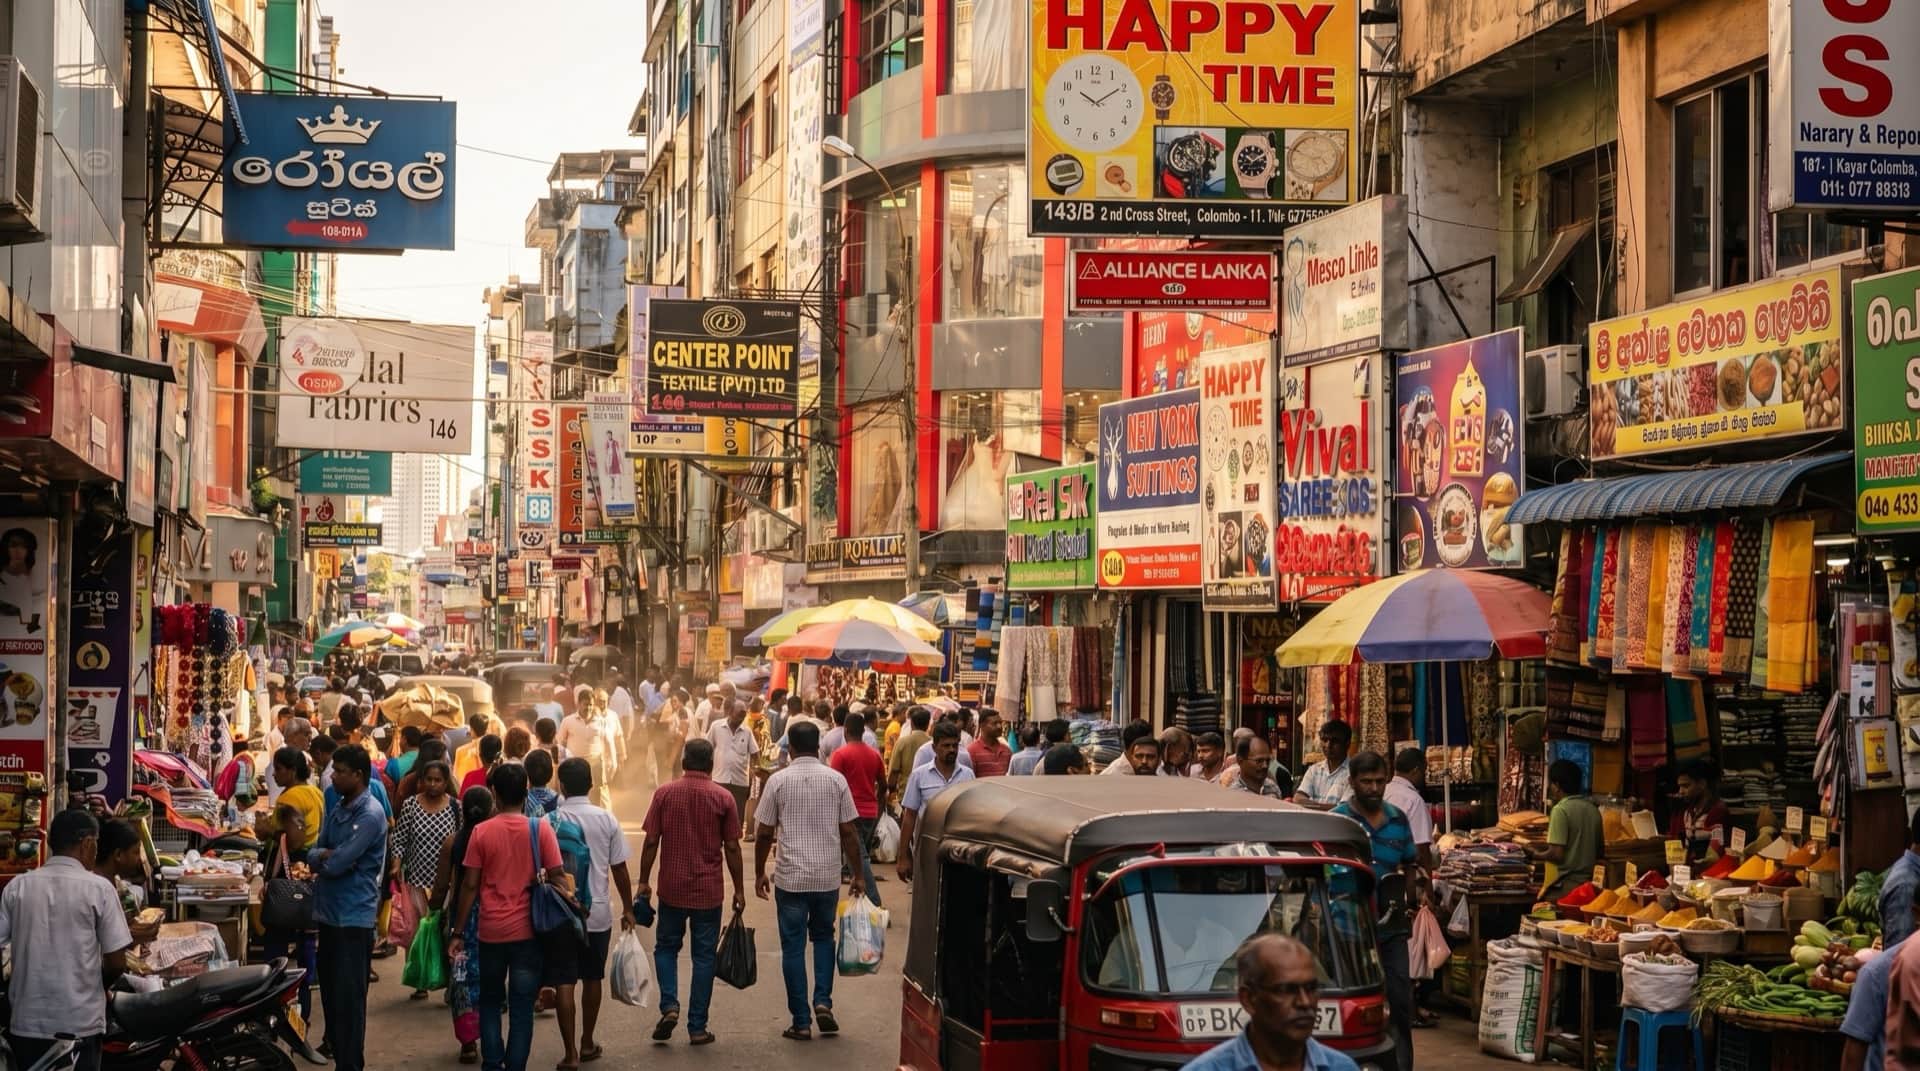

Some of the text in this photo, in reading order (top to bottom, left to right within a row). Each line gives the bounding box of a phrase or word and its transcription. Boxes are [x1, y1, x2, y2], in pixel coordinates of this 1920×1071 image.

[1048, 0, 1334, 55] HAPPY
[1075, 70, 1082, 80] 11
[1090, 65, 1101, 75] 12
[1110, 70, 1114, 80] 1
[1063, 81, 1072, 91] 10
[1121, 83, 1127, 92] 2
[1204, 64, 1336, 105] TIME
[1059, 98, 1065, 107] 9
[1126, 100, 1132, 109] 3
[1063, 115, 1070, 125] 8
[1121, 115, 1127, 125] 4
[1076, 128, 1082, 137] 7
[1093, 131, 1098, 141] 6
[1110, 128, 1116, 137] 5
[1800, 122, 1853, 147] Narary
[1859, 124, 1870, 144] &
[1836, 158, 1866, 176] Kayar
[1849, 181, 1872, 197] 077
[1045, 202, 1095, 221] 143/B
[1101, 208, 1107, 220] 2
[1110, 208, 1122, 221] nd
[1125, 209, 1153, 221] Cross
[1157, 208, 1191, 224] Street,
[1197, 209, 1240, 223] Colombo
[1103, 262, 1267, 279] ALLIANCE LANKA
[1308, 257, 1345, 288] Mesco
[653, 341, 794, 370] CENTER POINT
[359, 351, 404, 385] lal
[661, 375, 785, 397] TEXTILE (PVT) LTD
[1204, 358, 1266, 399] HAPPY
[1229, 399, 1262, 428] TIME
[429, 418, 457, 440] 146
[1127, 402, 1199, 454] NEW YORK
[1281, 400, 1374, 478] Vival
[1127, 456, 1197, 499] SUITINGS
[527, 497, 552, 521] 8B
